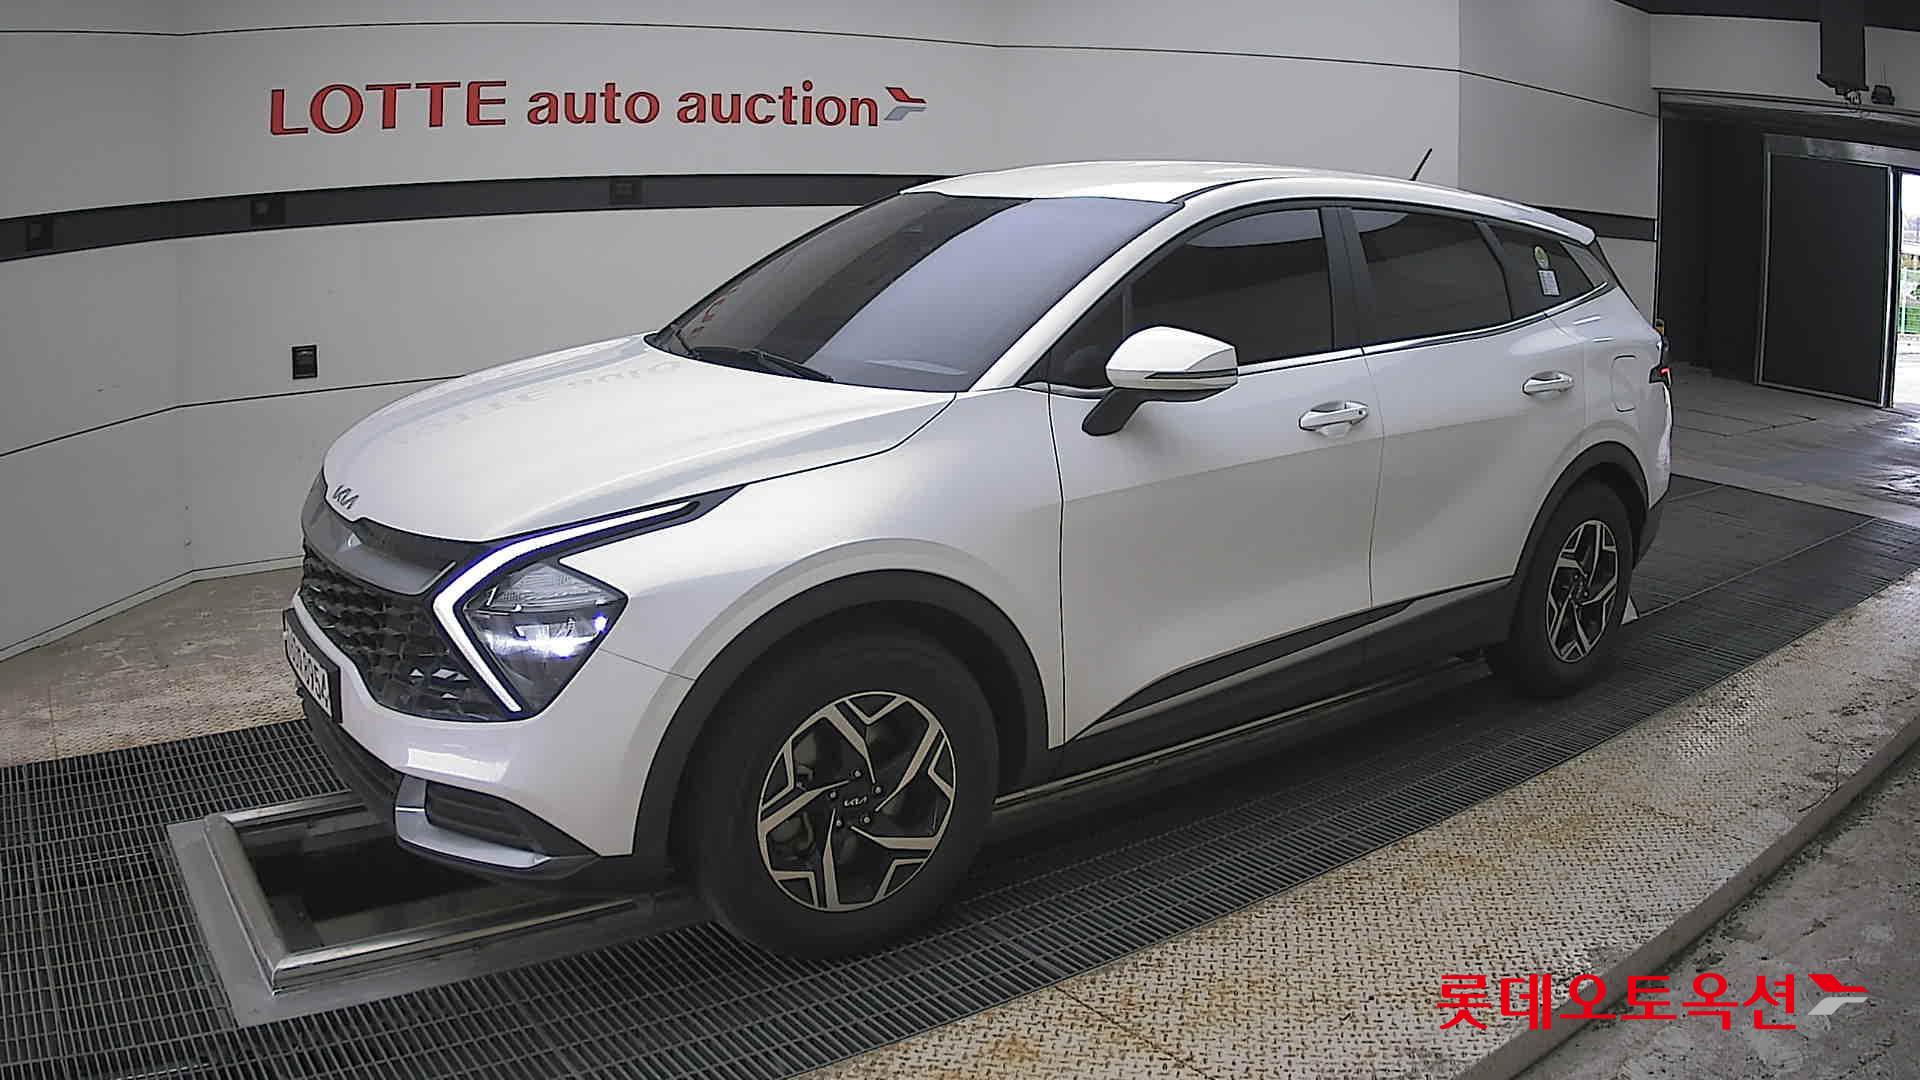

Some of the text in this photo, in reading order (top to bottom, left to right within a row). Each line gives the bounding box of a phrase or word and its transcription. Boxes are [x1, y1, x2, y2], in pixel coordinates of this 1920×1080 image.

[269, 80, 879, 136] LOTTE auto auction
